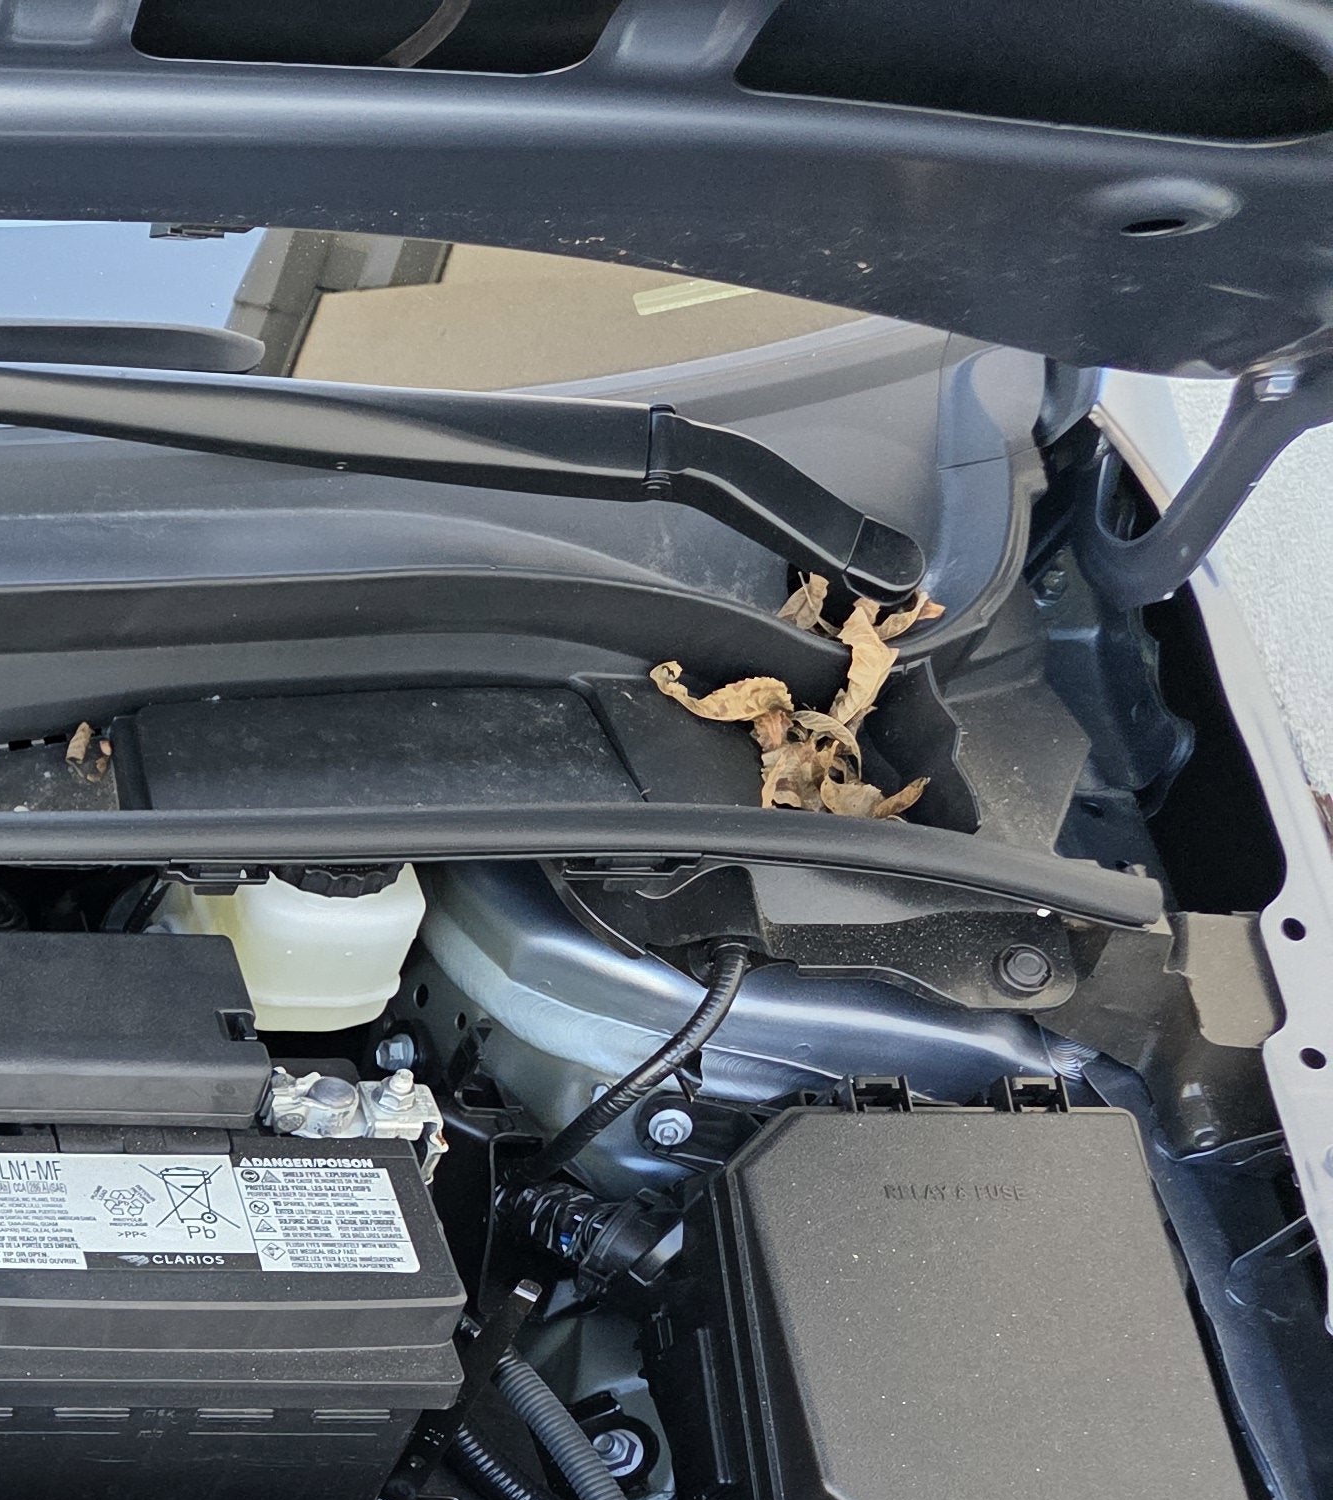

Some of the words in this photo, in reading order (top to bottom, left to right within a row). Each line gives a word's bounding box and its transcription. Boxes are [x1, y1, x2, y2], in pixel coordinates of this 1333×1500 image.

[250, 1158, 374, 1168] DANGER/POISON
[883, 1184, 947, 1201] RELAY
[975, 1185, 1029, 1201] FUSE
[187, 1225, 216, 1239] Pb
[152, 1254, 225, 1266] CLARIOS
